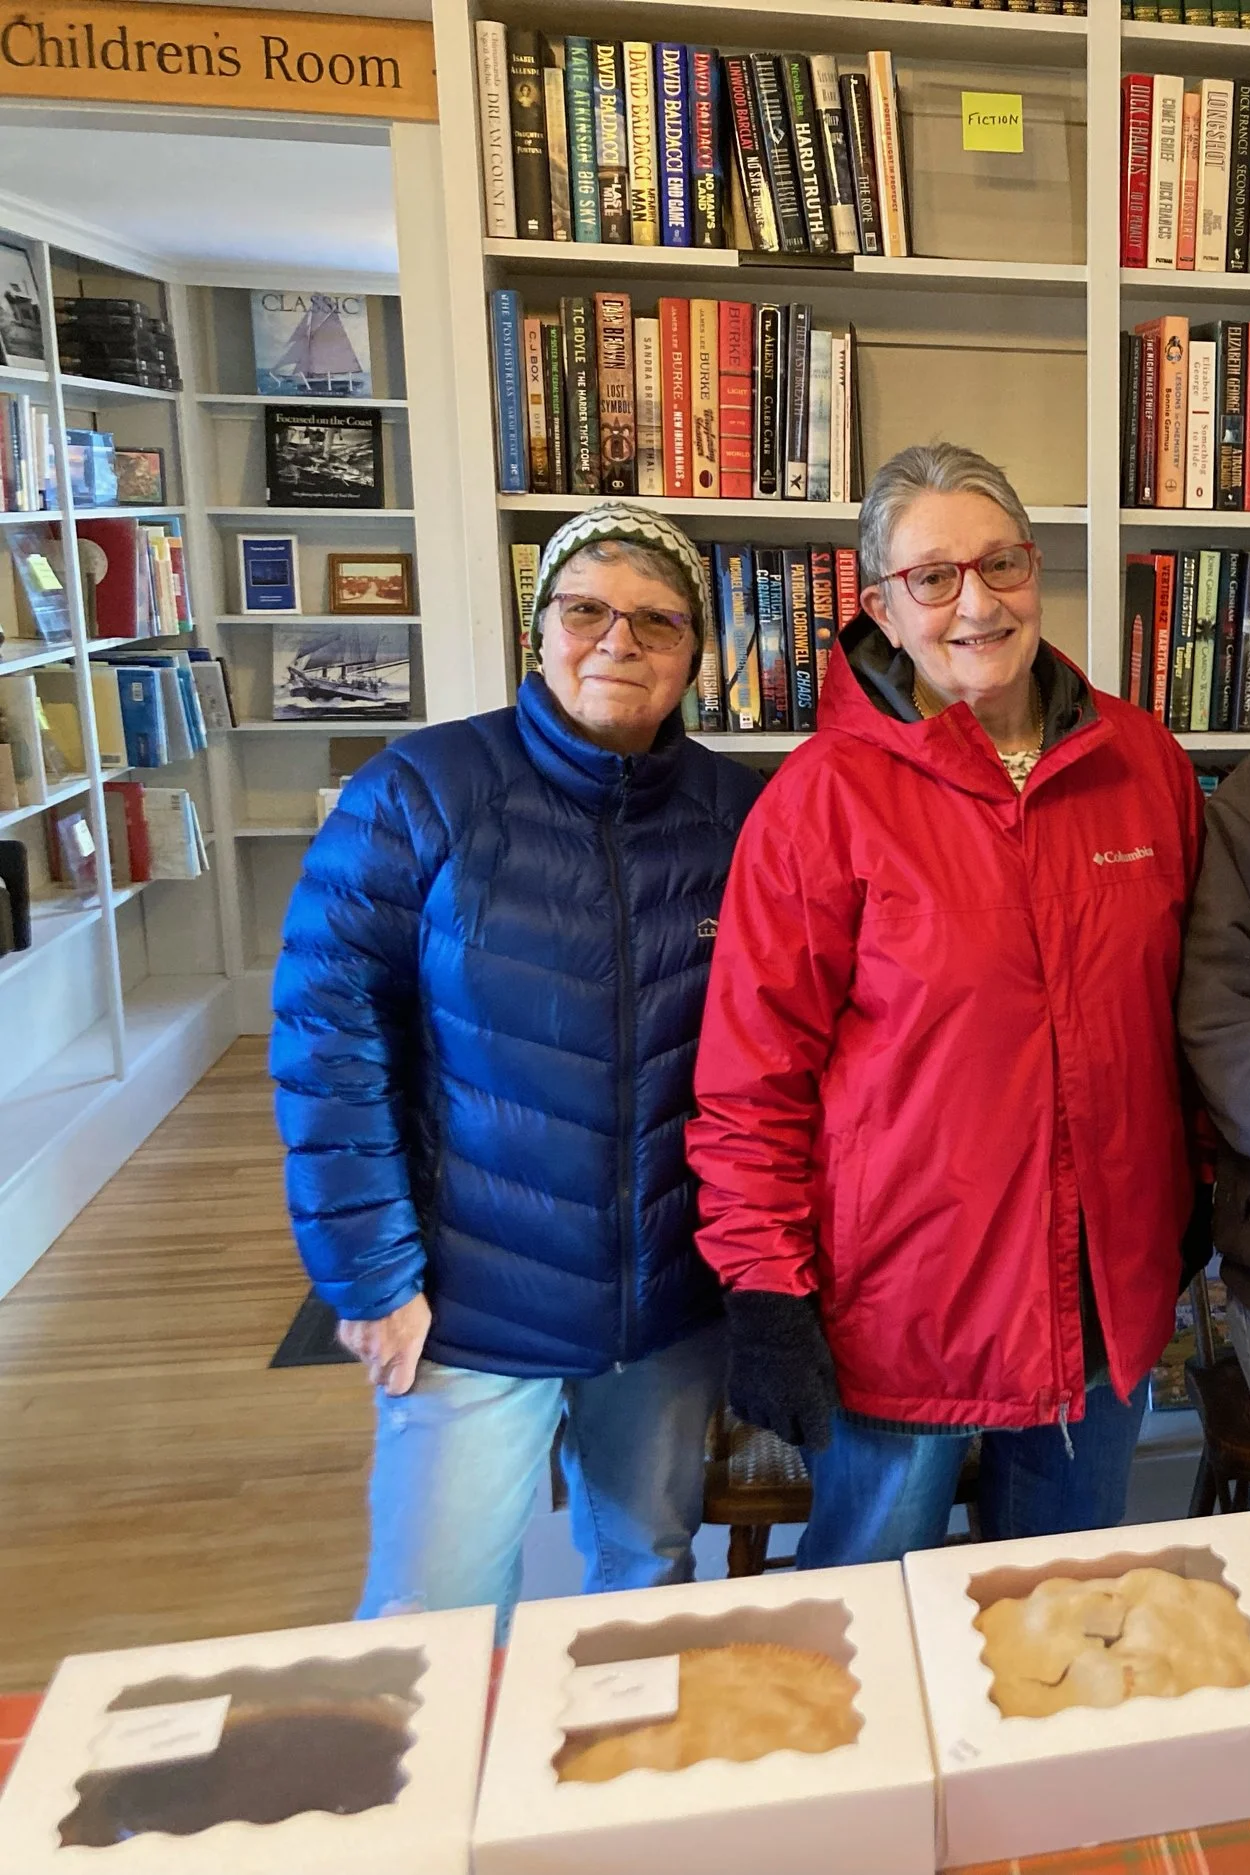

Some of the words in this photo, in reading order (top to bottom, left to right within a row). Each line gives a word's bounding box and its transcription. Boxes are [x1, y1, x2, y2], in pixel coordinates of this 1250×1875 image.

[0, 20, 241, 77] Children's
[261, 35, 402, 88] Room
[511, 65, 540, 75] ALLENDE
[513, 54, 535, 64] ISABEL
[571, 47, 589, 82] KATE
[597, 45, 616, 90] DAVID
[628, 50, 647, 96] DAVID
[662, 49, 682, 96] DAVID
[694, 52, 711, 96] DAVID
[728, 60, 745, 107] LINWOOD
[1129, 83, 1151, 112] DICK
[1161, 98, 1176, 124] COME
[1239, 86, 1250, 111] DICK
[573, 90, 593, 164] ATKINSON
[599, 95, 620, 166] BALDACCI
[695, 101, 714, 168] BALDACCI
[735, 109, 754, 151] BARCLAY
[968, 112, 1019, 126] FICTION
[1161, 125, 1175, 135] TO
[1205, 91, 1228, 171] LONGSHOT
[1238, 114, 1250, 156] FRANCIS
[631, 104, 651, 181] BALDACCI
[664, 100, 683, 173] BALDACCI
[795, 122, 815, 171] HARD
[1129, 119, 1150, 176] FRANCIS
[1160, 137, 1175, 162] GRIEF
[747, 156, 759, 169] NO
[577, 171, 595, 195] BIG
[667, 177, 683, 197] END
[697, 180, 707, 211] LAND
[705, 173, 714, 190] NO
[749, 171, 761, 198] SAFE
[858, 175, 869, 196] THE
[1159, 181, 1174, 201] DICK
[1235, 163, 1247, 205] SECOND
[579, 200, 597, 226] SKY
[631, 188, 643, 222] MAN
[668, 199, 685, 227] GAME
[803, 176, 825, 235] TRUTH
[860, 197, 873, 223] ROPE
[1158, 203, 1172, 240] FRANCIS
[1234, 207, 1246, 236] WIND
[262, 294, 359, 315] CLASSIC
[602, 300, 623, 323] DAN
[574, 327, 586, 363] BOYLE
[604, 327, 625, 370] BROWN
[728, 307, 740, 367] BURKE
[1227, 326, 1241, 375] ELIZABETH
[530, 356, 539, 382] BOX
[644, 337, 652, 380] SANDRA
[672, 351, 683, 400] BURKE
[1146, 352, 1154, 397] NIGHTMARE
[577, 371, 586, 387] THE
[606, 384, 625, 398] LOST
[700, 352, 710, 400] BURKE
[727, 387, 747, 395] LIGHT
[1202, 356, 1210, 402] Elizabeth
[578, 389, 588, 422] HARDER
[601, 400, 631, 414] SYMBOL
[1145, 398, 1153, 420] THIEF
[1164, 387, 1172, 417] Bonnie
[1226, 378, 1241, 413] GEORGE
[276, 414, 315, 423] Focused
[330, 416, 345, 425] the
[346, 416, 372, 426] Coast
[579, 424, 589, 446] THEY
[674, 411, 683, 429] NEW
[674, 430, 684, 454] IBERIA
[1199, 424, 1208, 475] Something
[581, 448, 590, 471] COME
[675, 455, 685, 479] BLUES
[1232, 455, 1242, 487] TRAITOR
[520, 568, 533, 588] LEE
[730, 557, 743, 589] MICHAEL
[791, 564, 806, 609] PATRICIA
[1160, 565, 1170, 608] VERTIGO
[521, 593, 535, 626] CHILD
[757, 569, 771, 623] CORNWELL
[770, 574, 783, 621] PATRICIA
[813, 580, 833, 620] COSBY
[1227, 580, 1238, 622] GRISHAM
[793, 610, 809, 666] CORNWELL
[1156, 629, 1167, 671] MARTHA
[1184, 642, 1194, 669] Rogue
[1223, 644, 1234, 684] CAMINO
[701, 652, 719, 711] NIGHTSHADE
[796, 670, 812, 708] CHAOS
[1155, 673, 1166, 711] GRIMES
[1104, 846, 1154, 863] Columbia
